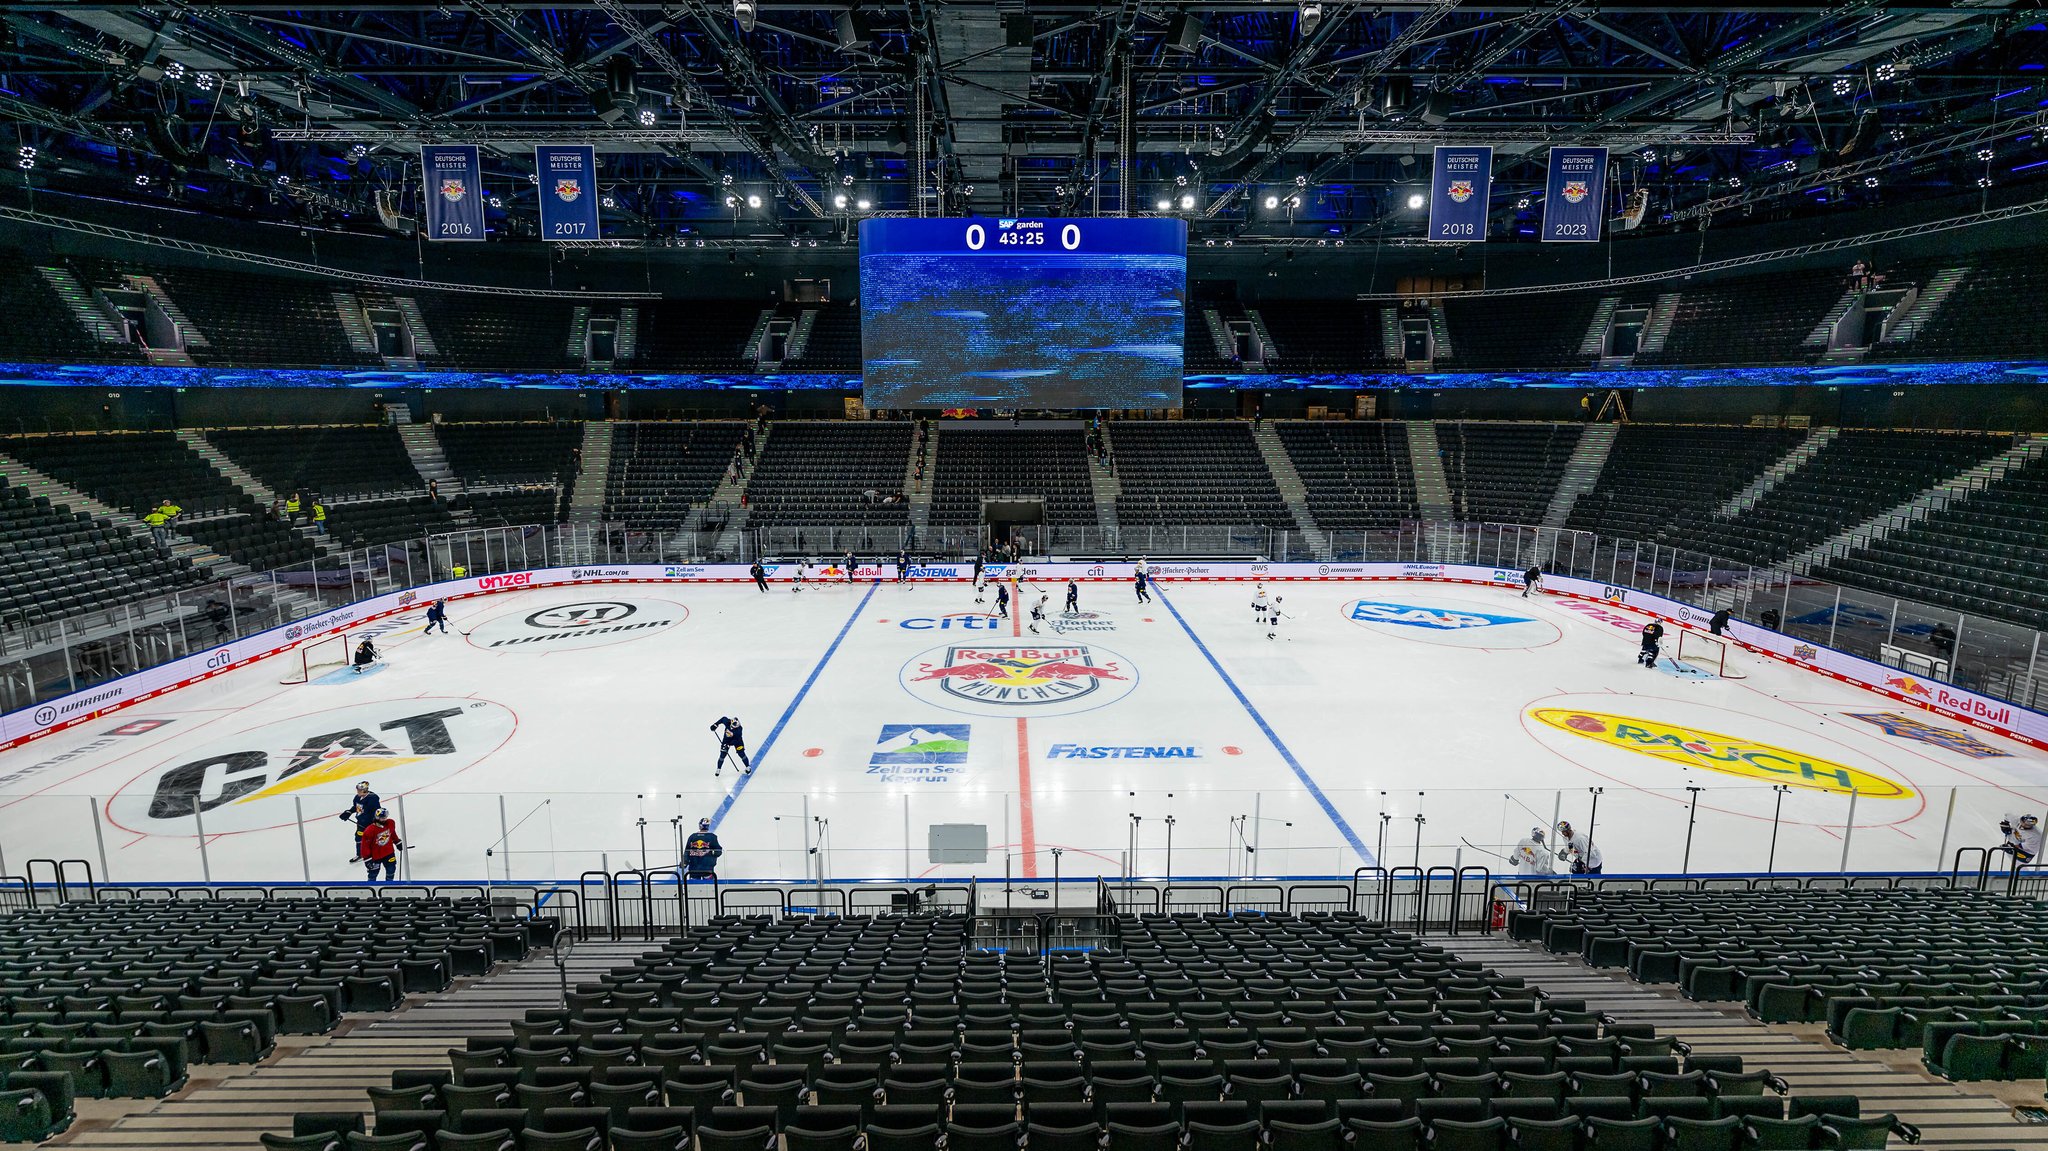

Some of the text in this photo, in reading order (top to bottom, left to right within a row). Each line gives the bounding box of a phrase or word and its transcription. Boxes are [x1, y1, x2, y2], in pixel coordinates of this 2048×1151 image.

[441, 223, 472, 235] 2016
[555, 223, 586, 235] 2017
[1017, 221, 1043, 230] garden
[1442, 223, 1474, 235] 2018
[1555, 224, 1587, 235] 2023
[966, 224, 986, 250] 0
[1000, 232, 1044, 245] 43:25
[1062, 224, 1081, 250] 0
[866, 568, 882, 576] Bull
[906, 566, 958, 577] FASTENAL
[1088, 567, 1104, 576] citi
[479, 572, 533, 589] unzer
[1604, 586, 1628, 602] CAT
[1358, 604, 1491, 628] SAP
[303, 611, 354, 635] Hacker-Pschorr
[900, 616, 999, 630] citi
[489, 620, 671, 648] WARRIOR
[207, 650, 231, 669] citi
[957, 649, 1078, 659] Red Bull
[1818, 668, 1834, 677] PENNY.
[1846, 678, 1863, 686] PENNY.
[958, 680, 1083, 699] MÜNCHEN
[1871, 686, 1889, 696] PENNY.
[60, 688, 122, 714] WARRIOR
[1902, 696, 1922, 706] PENNY.
[1938, 689, 2010, 724] Red Bull
[1934, 707, 1956, 718] PENNY.
[67, 716, 88, 726] PENNY.
[1972, 720, 1995, 731] PENNY.
[30, 728, 52, 739] PENNY.
[2010, 732, 2033, 744] PENNY.
[1046, 743, 1203, 759] FASTENAL
[1615, 723, 1852, 788] RAUCH
[148, 706, 464, 819] CAT
[866, 766, 900, 774] Zell
[880, 775, 948, 784] Kaprun
